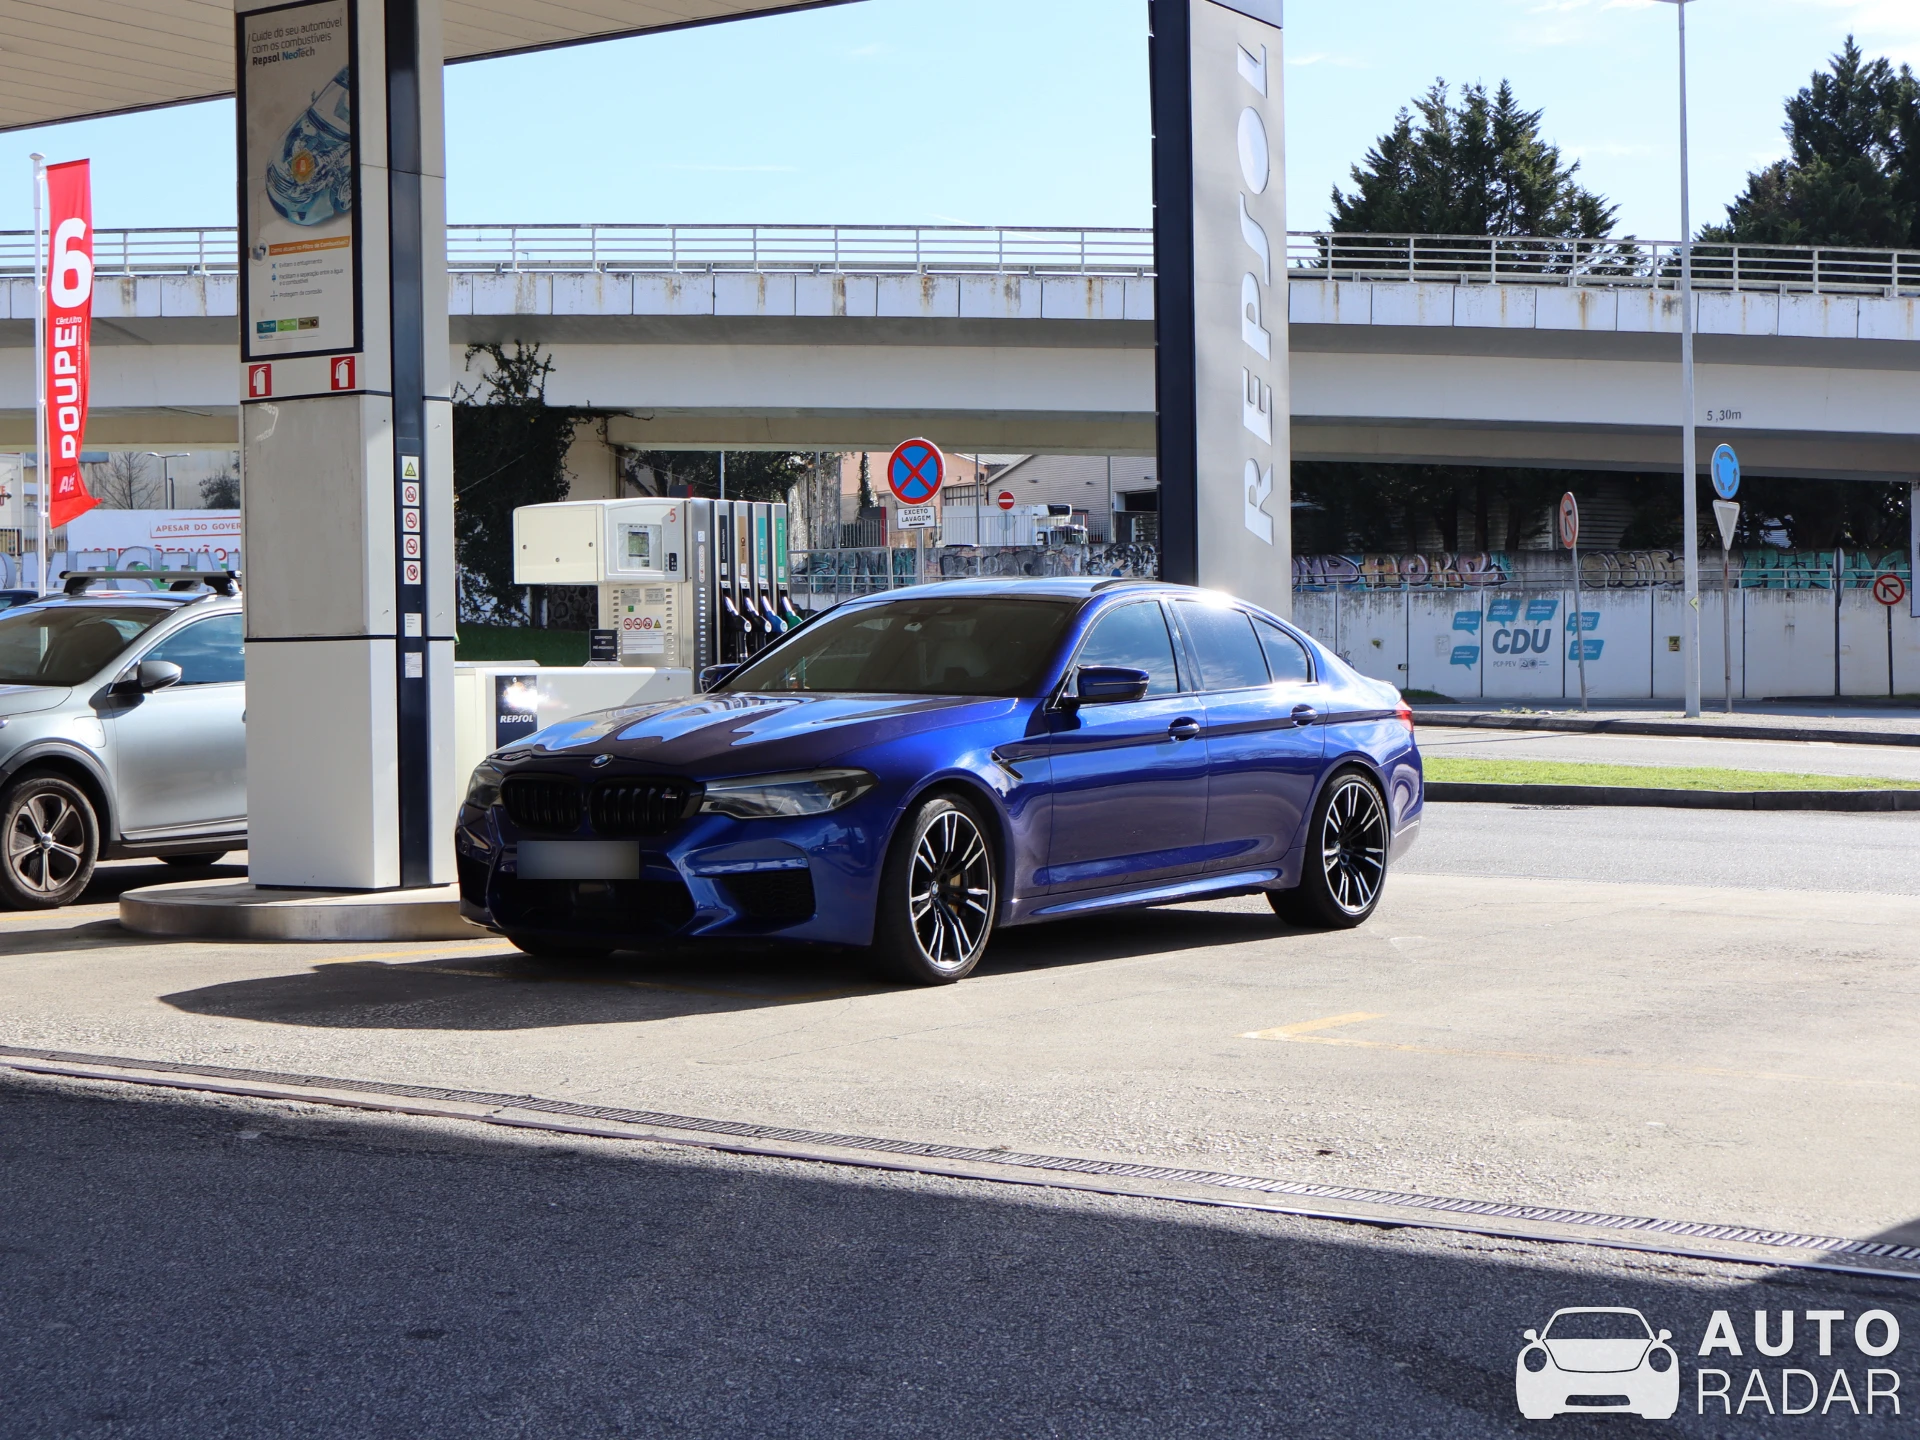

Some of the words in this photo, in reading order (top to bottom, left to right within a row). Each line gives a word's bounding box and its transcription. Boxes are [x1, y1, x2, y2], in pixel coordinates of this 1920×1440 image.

[252, 30, 272, 42] Cuide
[274, 28, 283, 38] do
[285, 27, 298, 36] seu
[301, 17, 342, 33] automóvel
[252, 44, 268, 54] com
[270, 42, 279, 51] os
[281, 32, 332, 49] combustíveis
[252, 52, 280, 66] Repsol
[282, 46, 315, 61] NeoTech
[50, 217, 92, 308] 6
[1237, 42, 1274, 547] REPSOL
[54, 325, 79, 459] POUPE
[155, 524, 189, 532] APESAR
[194, 523, 207, 531] DO
[212, 522, 241, 530] GOVER
[669, 508, 677, 523] 5
[1492, 628, 1551, 655] CDU
[500, 714, 533, 723] REPSOL
